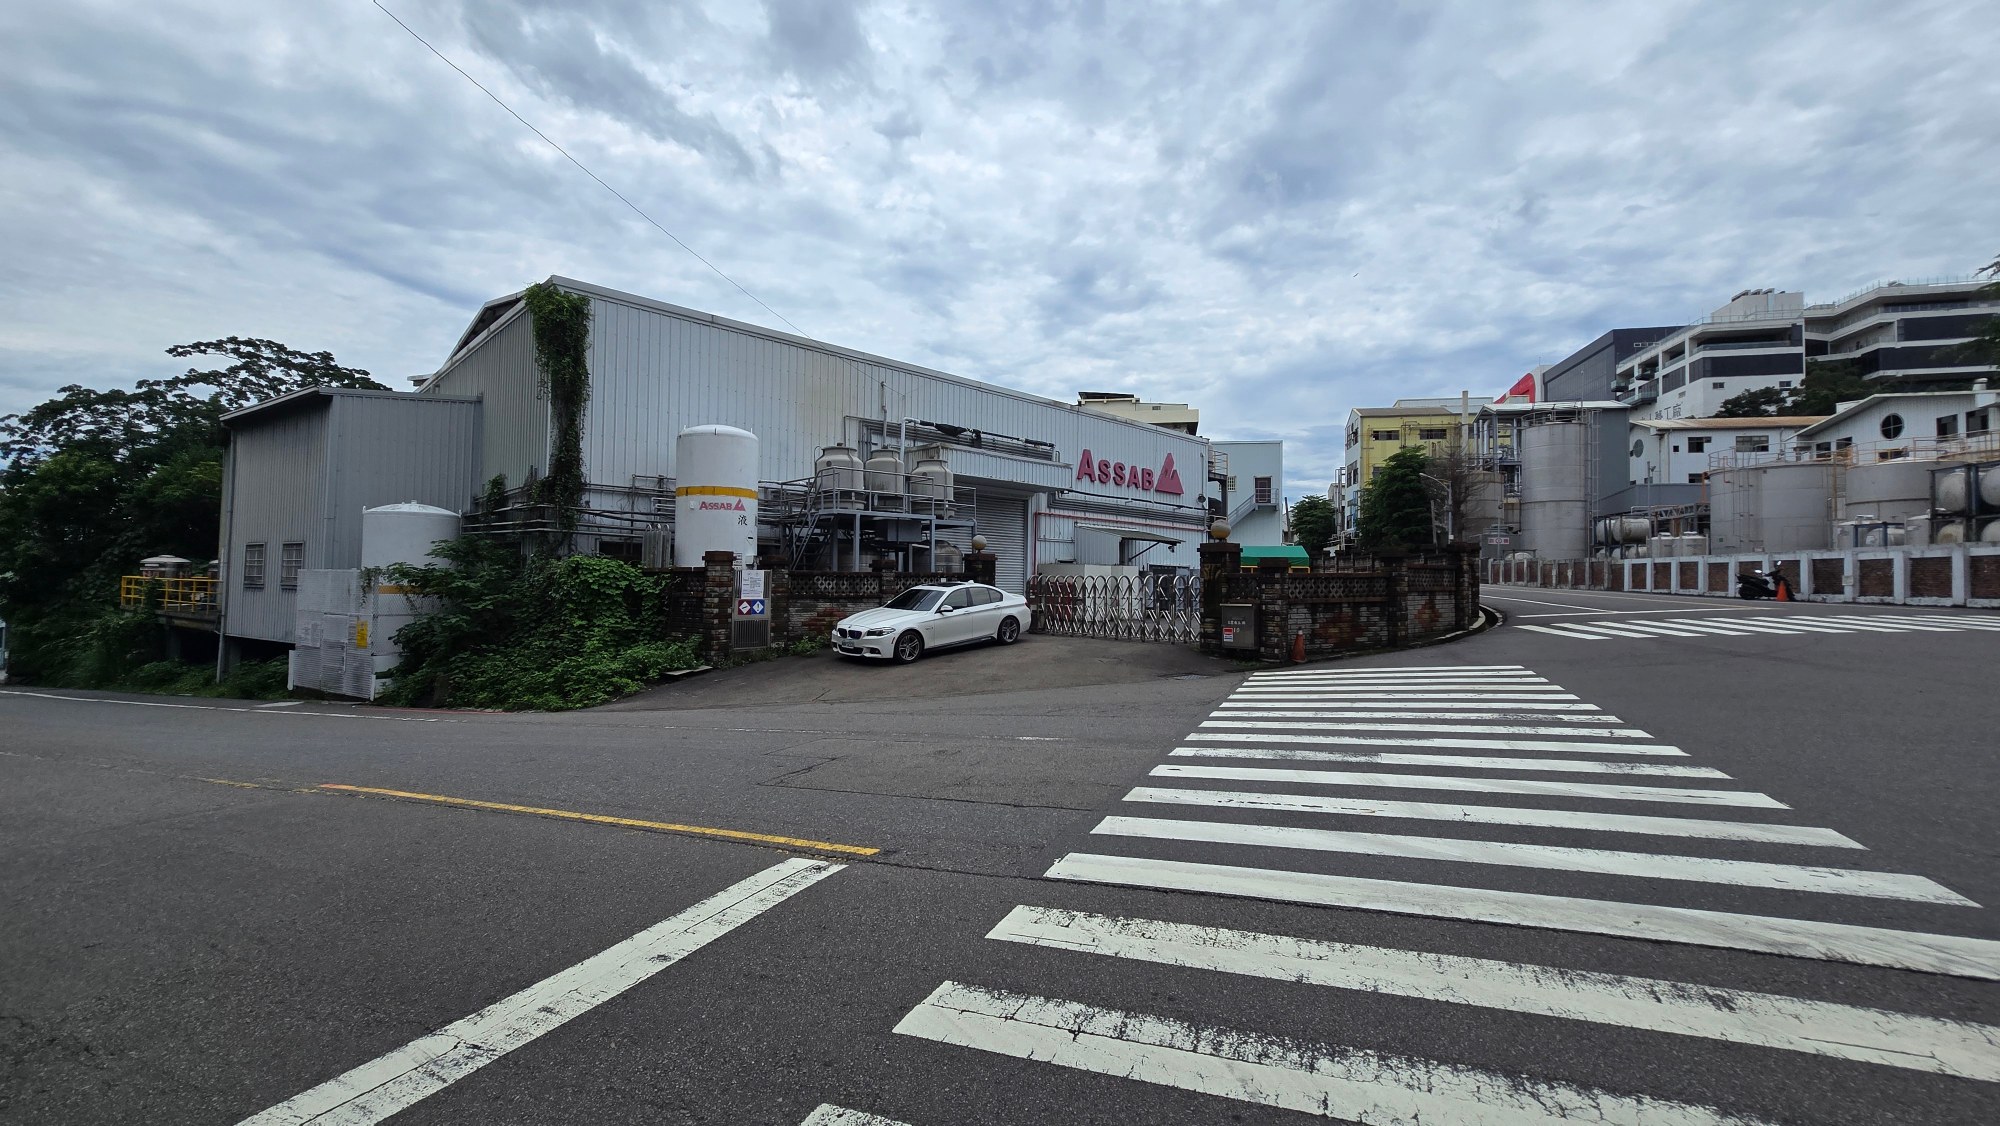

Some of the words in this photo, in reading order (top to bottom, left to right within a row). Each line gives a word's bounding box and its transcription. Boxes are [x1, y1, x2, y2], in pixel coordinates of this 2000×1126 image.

[1077, 449, 1154, 491] ASSAB
[699, 501, 733, 511] ASSAB
[737, 514, 748, 526] 液
